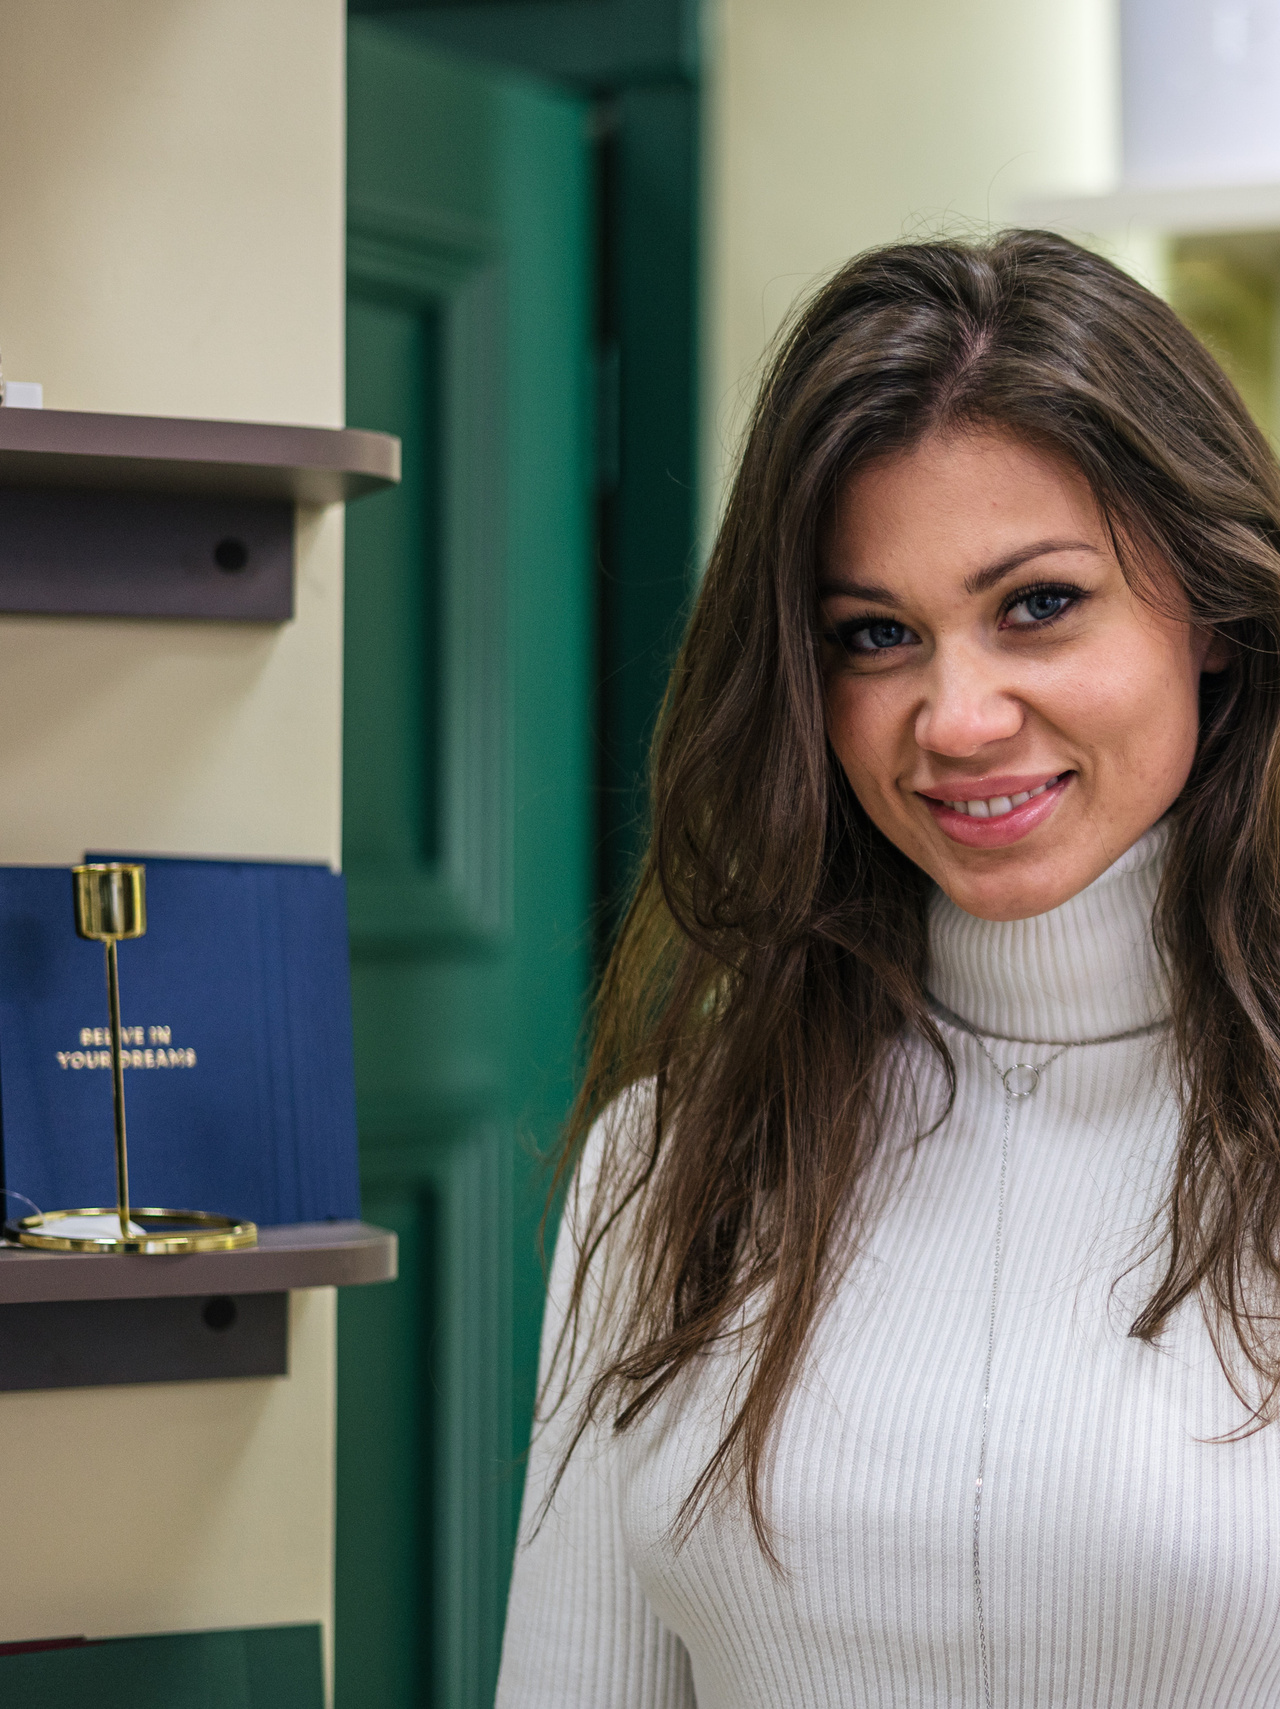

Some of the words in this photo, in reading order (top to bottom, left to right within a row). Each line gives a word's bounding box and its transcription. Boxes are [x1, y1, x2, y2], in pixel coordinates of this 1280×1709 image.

[149, 1025, 171, 1046] IN
[57, 1050, 112, 1070] YOUR
[118, 1047, 197, 1069] DREAMS
